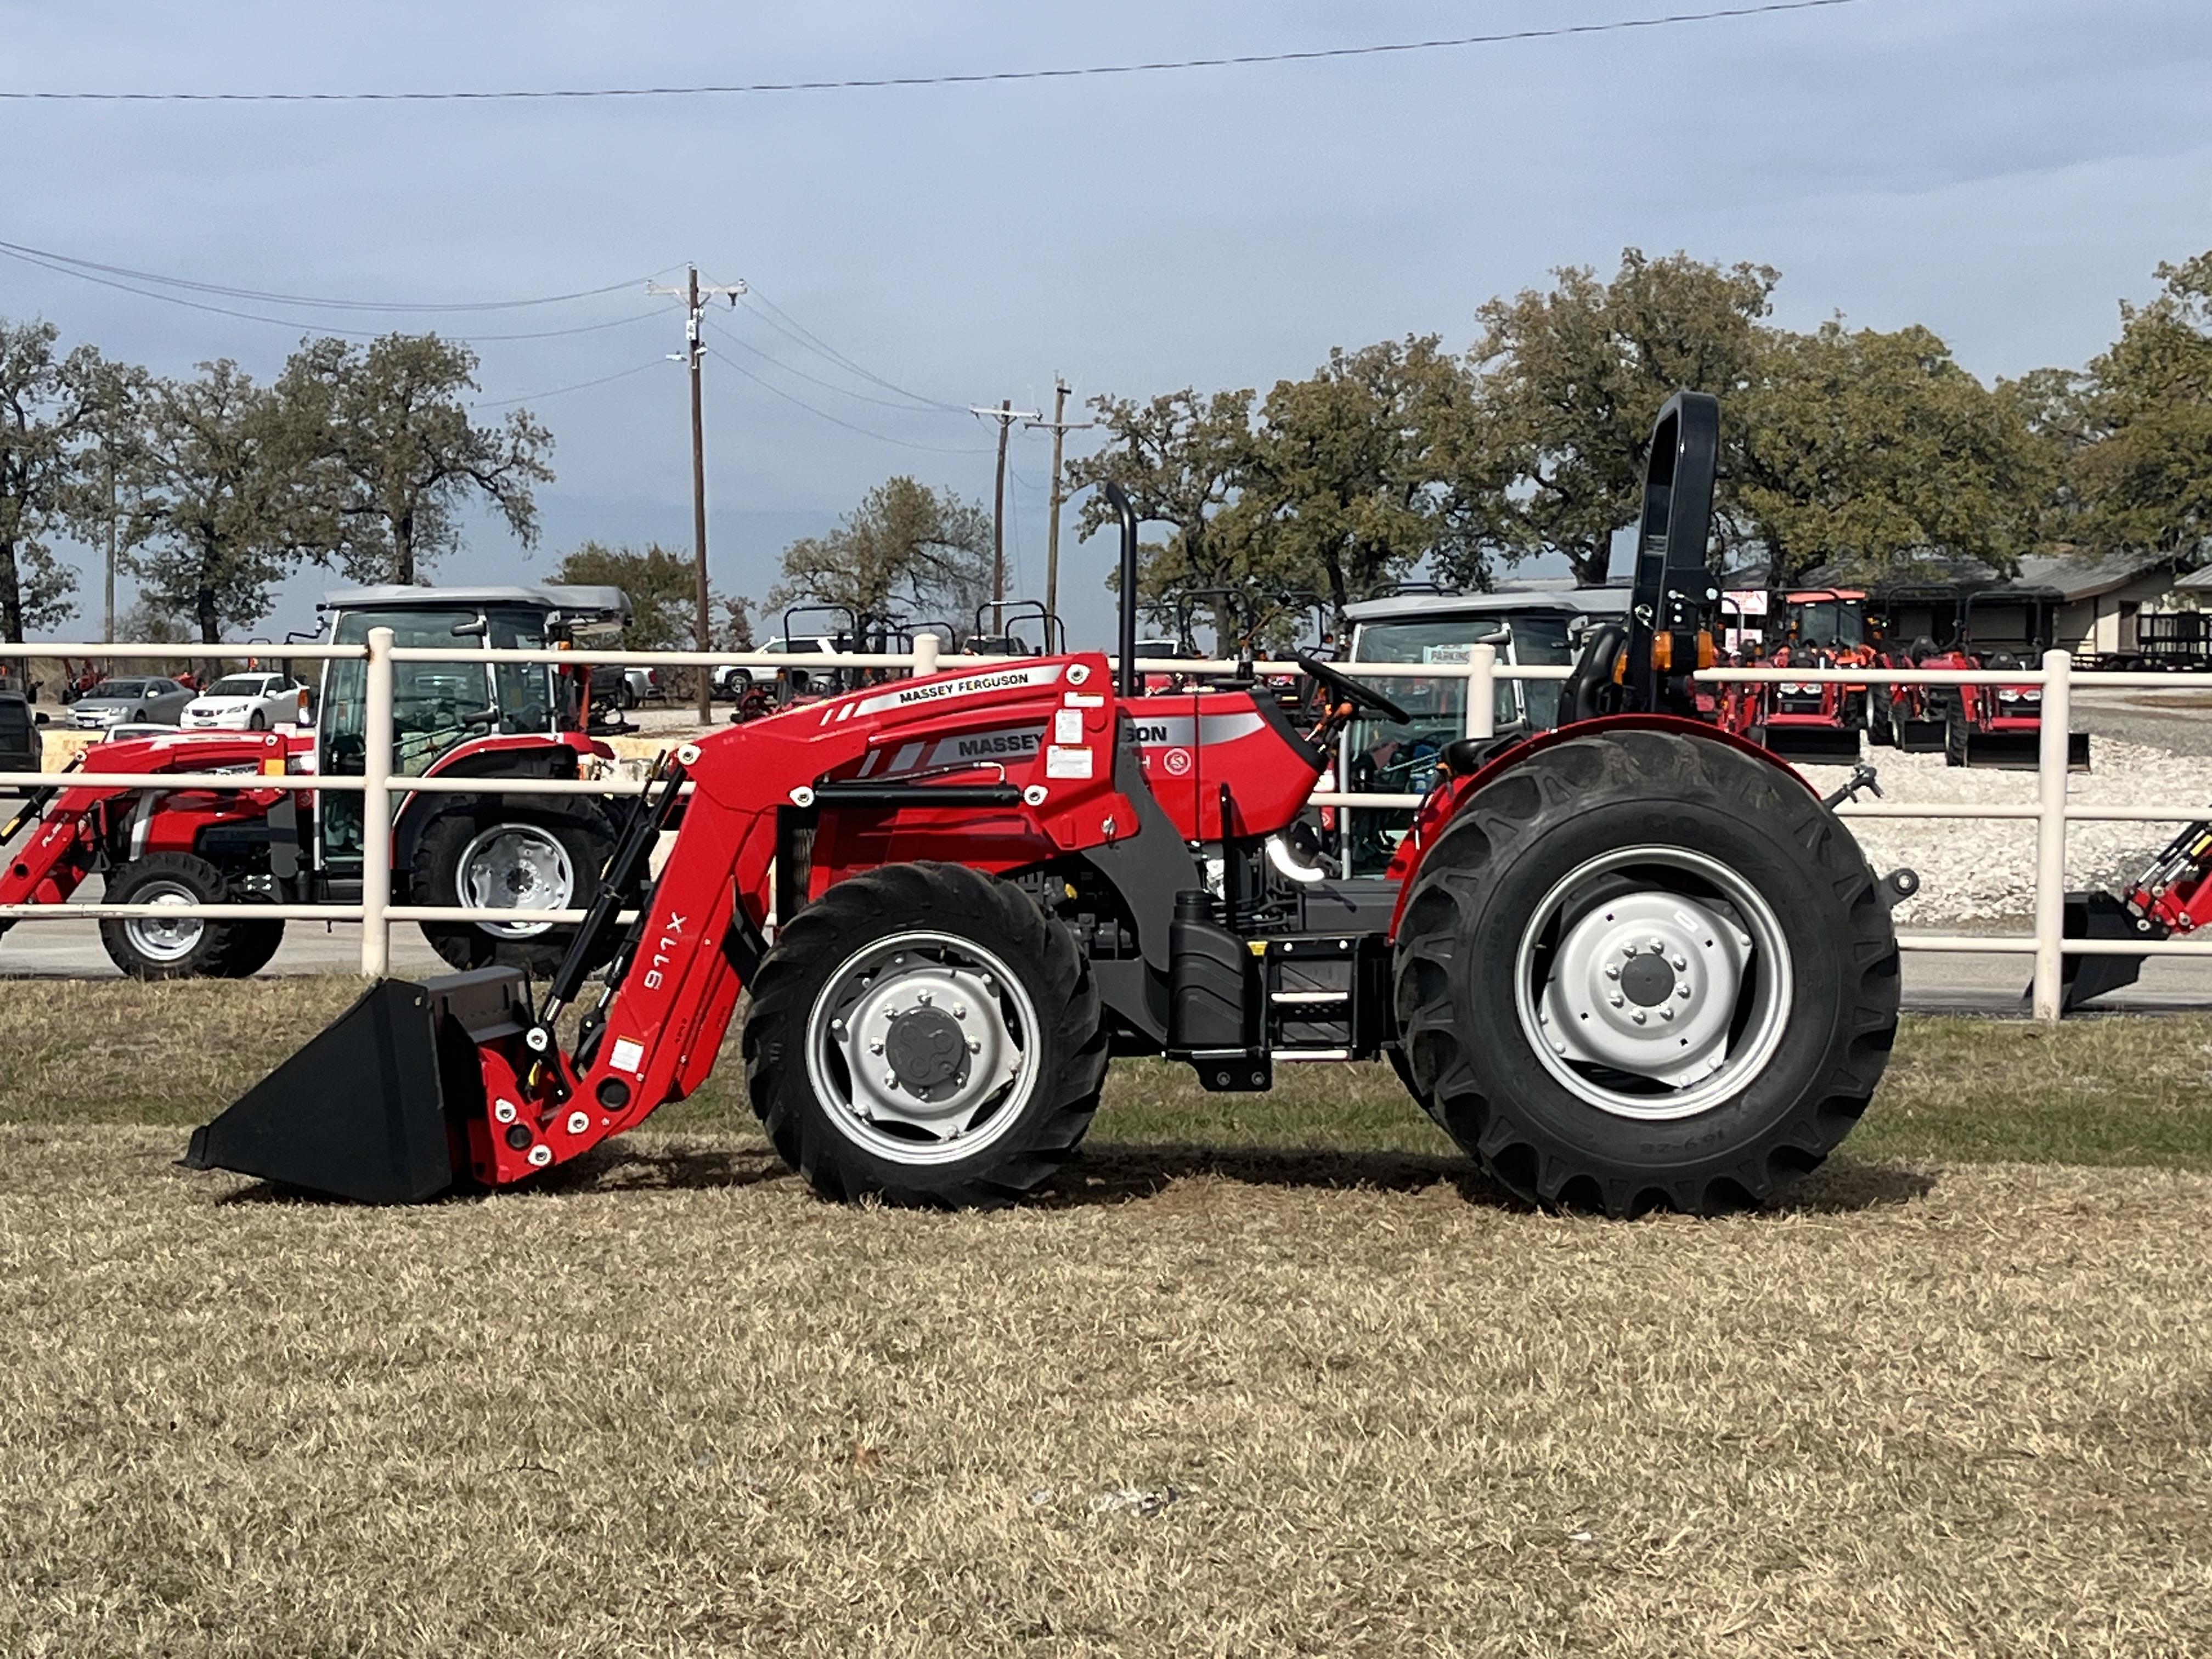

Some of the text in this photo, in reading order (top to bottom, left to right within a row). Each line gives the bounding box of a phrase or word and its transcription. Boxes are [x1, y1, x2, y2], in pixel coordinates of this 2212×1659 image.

[899, 674, 1029, 703] MASSEY FERGUSON
[958, 733, 1045, 757] MASSEY
[644, 911, 687, 990] 911X
